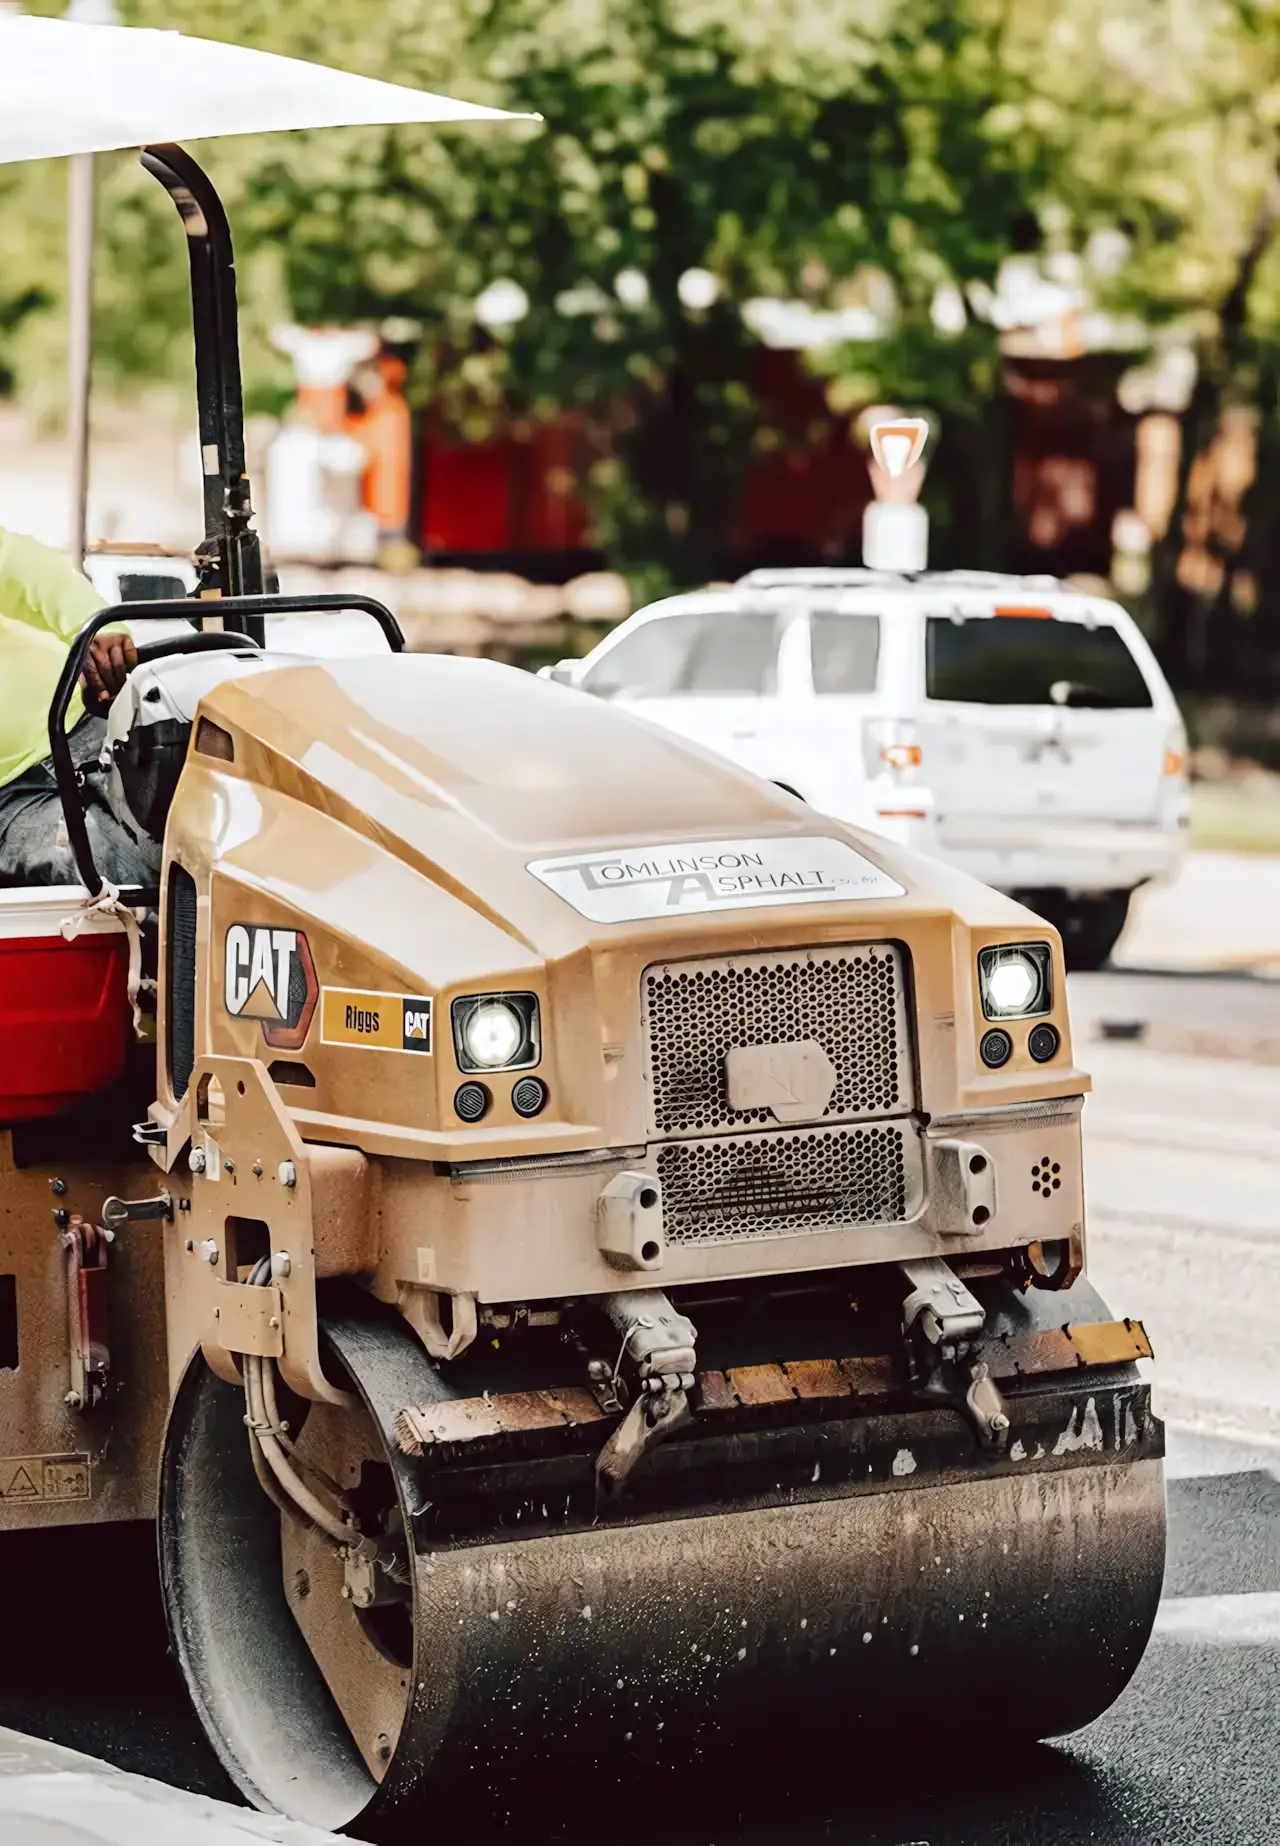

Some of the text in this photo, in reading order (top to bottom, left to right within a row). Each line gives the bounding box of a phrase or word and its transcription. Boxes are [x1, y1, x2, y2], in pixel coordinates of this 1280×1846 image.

[543, 852, 764, 890] TOMLINSON
[666, 870, 826, 905] ASPHALT
[225, 923, 297, 1020] CAT
[345, 1005, 430, 1039] Riggs CAT
